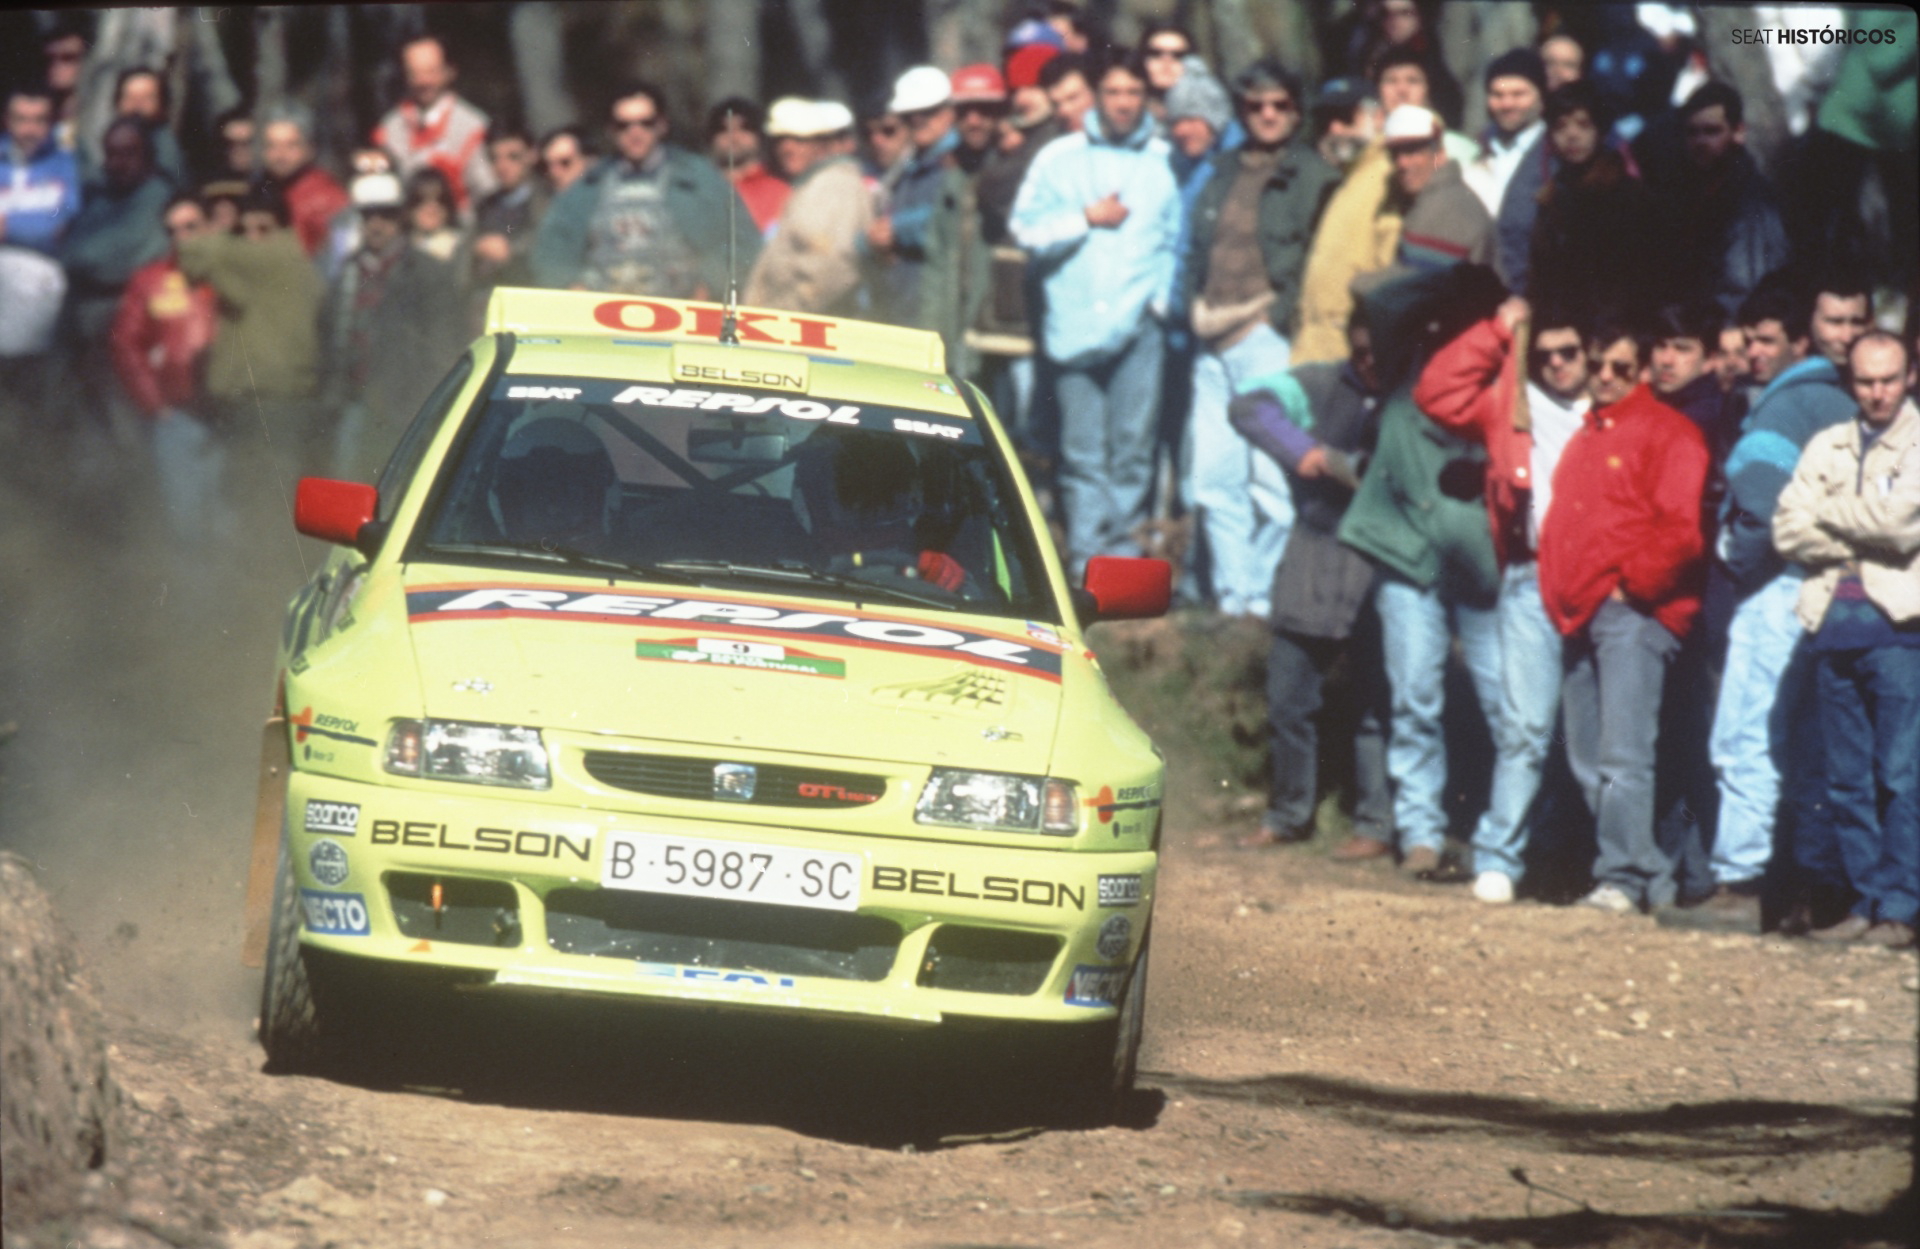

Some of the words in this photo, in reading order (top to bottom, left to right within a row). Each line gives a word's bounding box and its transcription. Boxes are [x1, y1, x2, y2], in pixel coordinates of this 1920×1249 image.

[593, 300, 837, 350] OKI
[681, 364, 803, 388] BELSON
[612, 385, 860, 425] REPSOL
[438, 588, 1032, 664] REPSOL
[371, 820, 591, 861] BELSON
[872, 866, 1085, 911] BELSON
